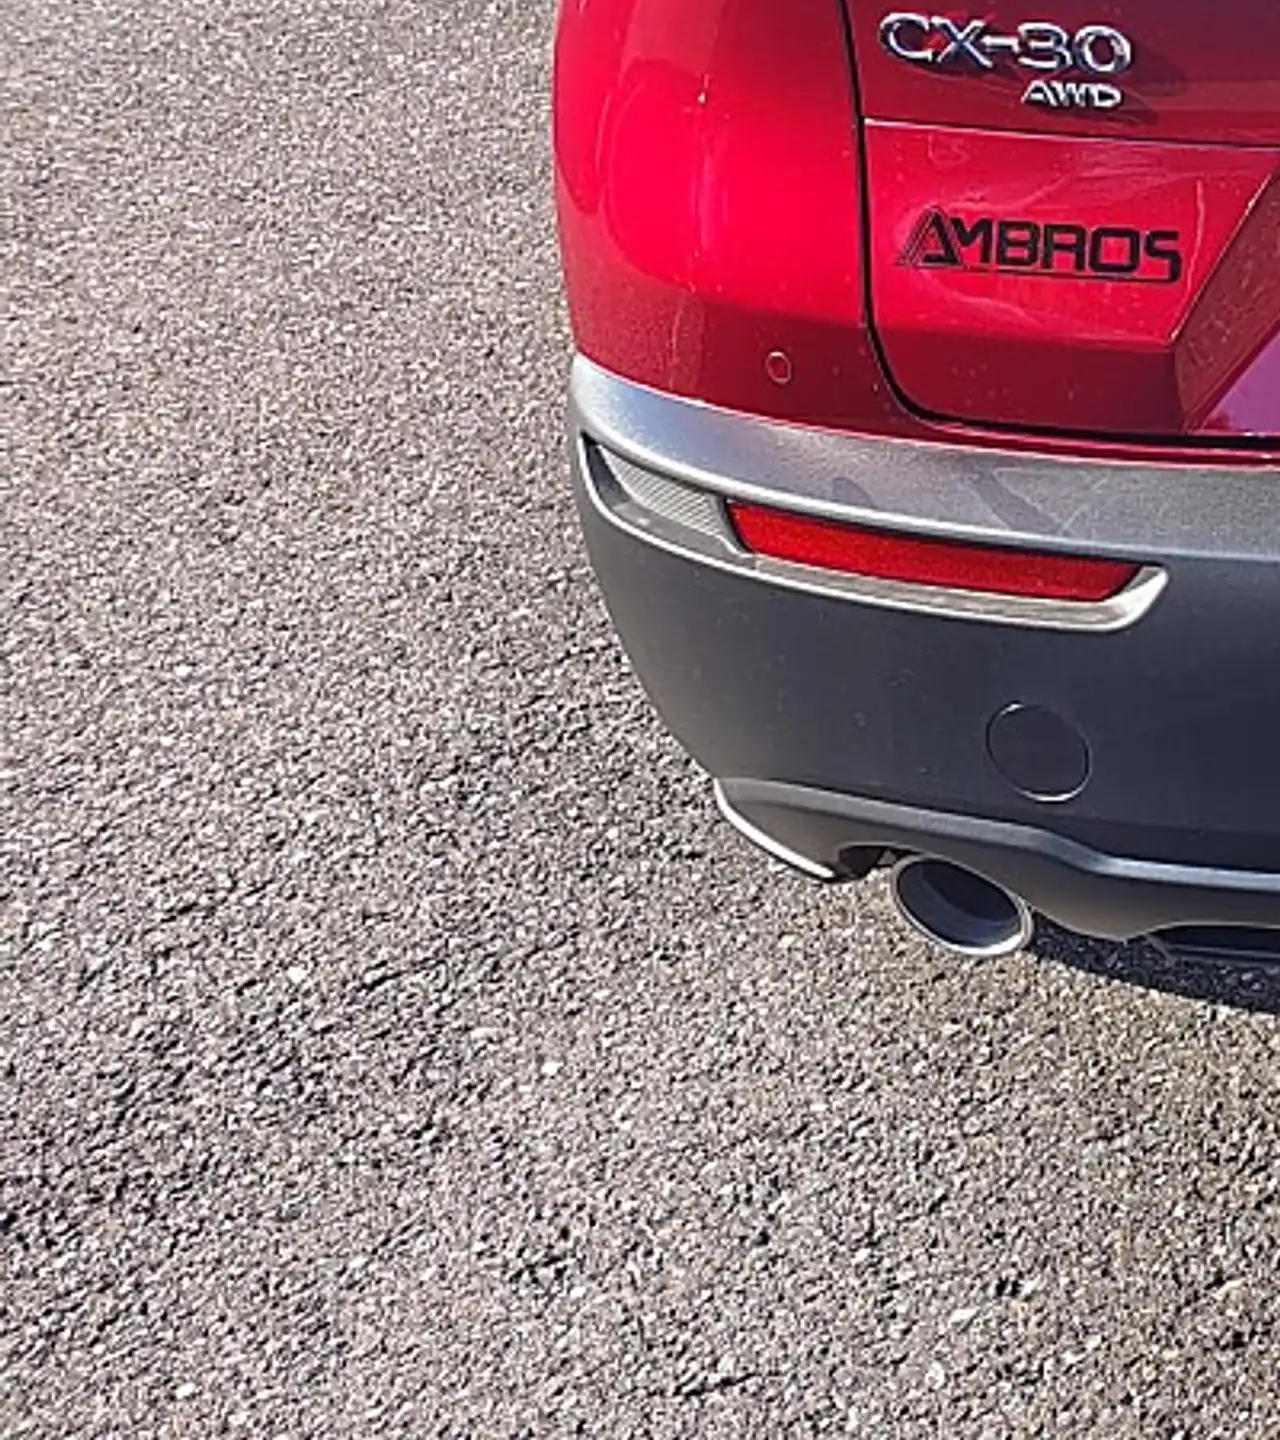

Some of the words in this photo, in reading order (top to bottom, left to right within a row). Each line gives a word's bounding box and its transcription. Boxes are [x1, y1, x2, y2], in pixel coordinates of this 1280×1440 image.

[879, 11, 1133, 75] CX-30
[1021, 79, 1123, 110] AWD
[896, 205, 1183, 283] AMBROS
